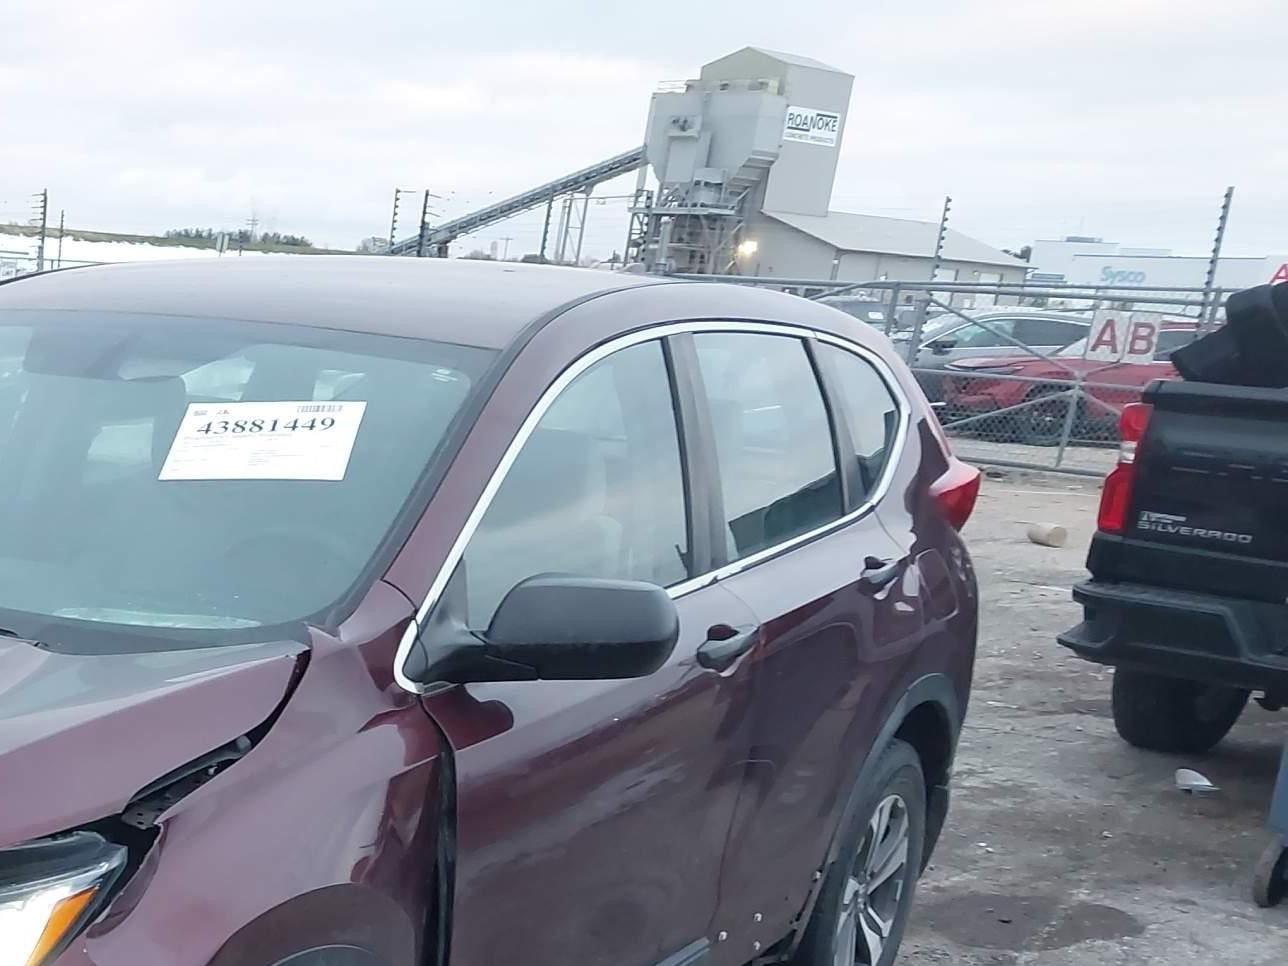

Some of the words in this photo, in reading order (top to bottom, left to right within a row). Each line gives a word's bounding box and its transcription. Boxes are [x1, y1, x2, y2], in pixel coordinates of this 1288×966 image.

[787, 112, 839, 133] ROANOKE
[1100, 265, 1146, 285] Sysco
[195, 416, 336, 435] 43881449
[1136, 520, 1254, 543] SILVERADO
